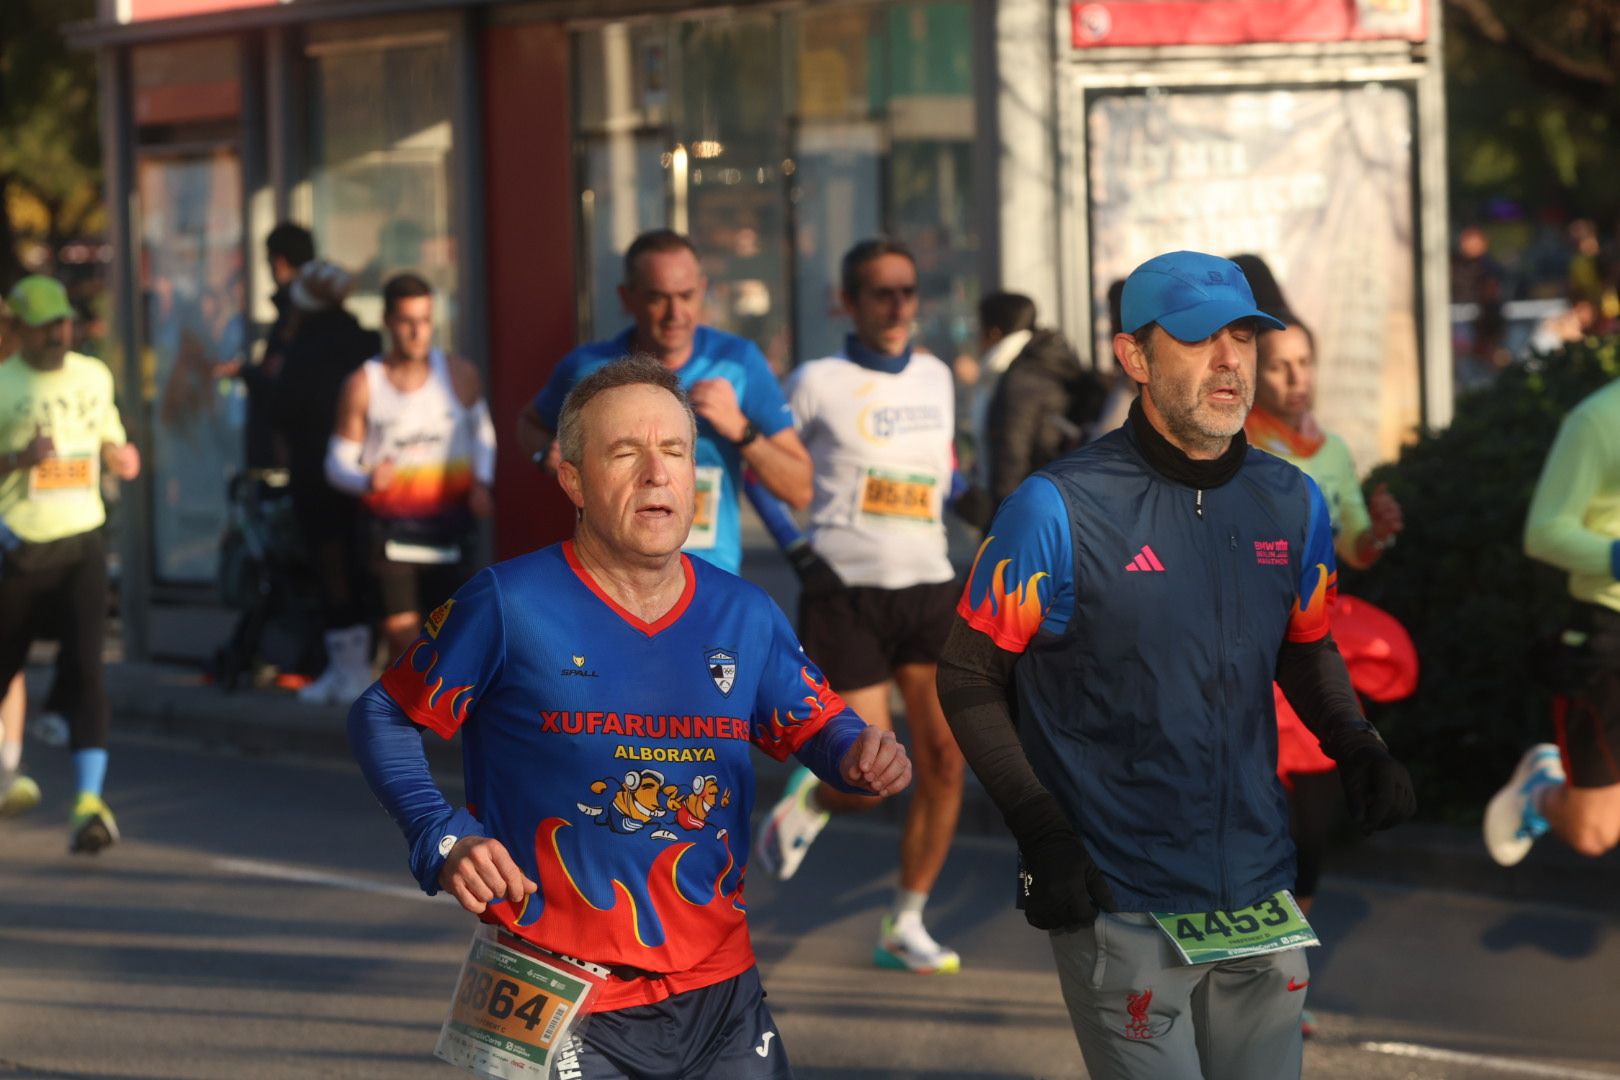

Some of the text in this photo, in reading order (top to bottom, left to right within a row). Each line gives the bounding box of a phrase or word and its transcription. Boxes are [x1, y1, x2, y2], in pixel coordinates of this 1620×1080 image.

[560, 668, 600, 678] SPALL
[539, 710, 750, 742] XUFARUNNERS
[614, 745, 716, 763] ALBORAYA
[1177, 895, 1289, 942] 4453
